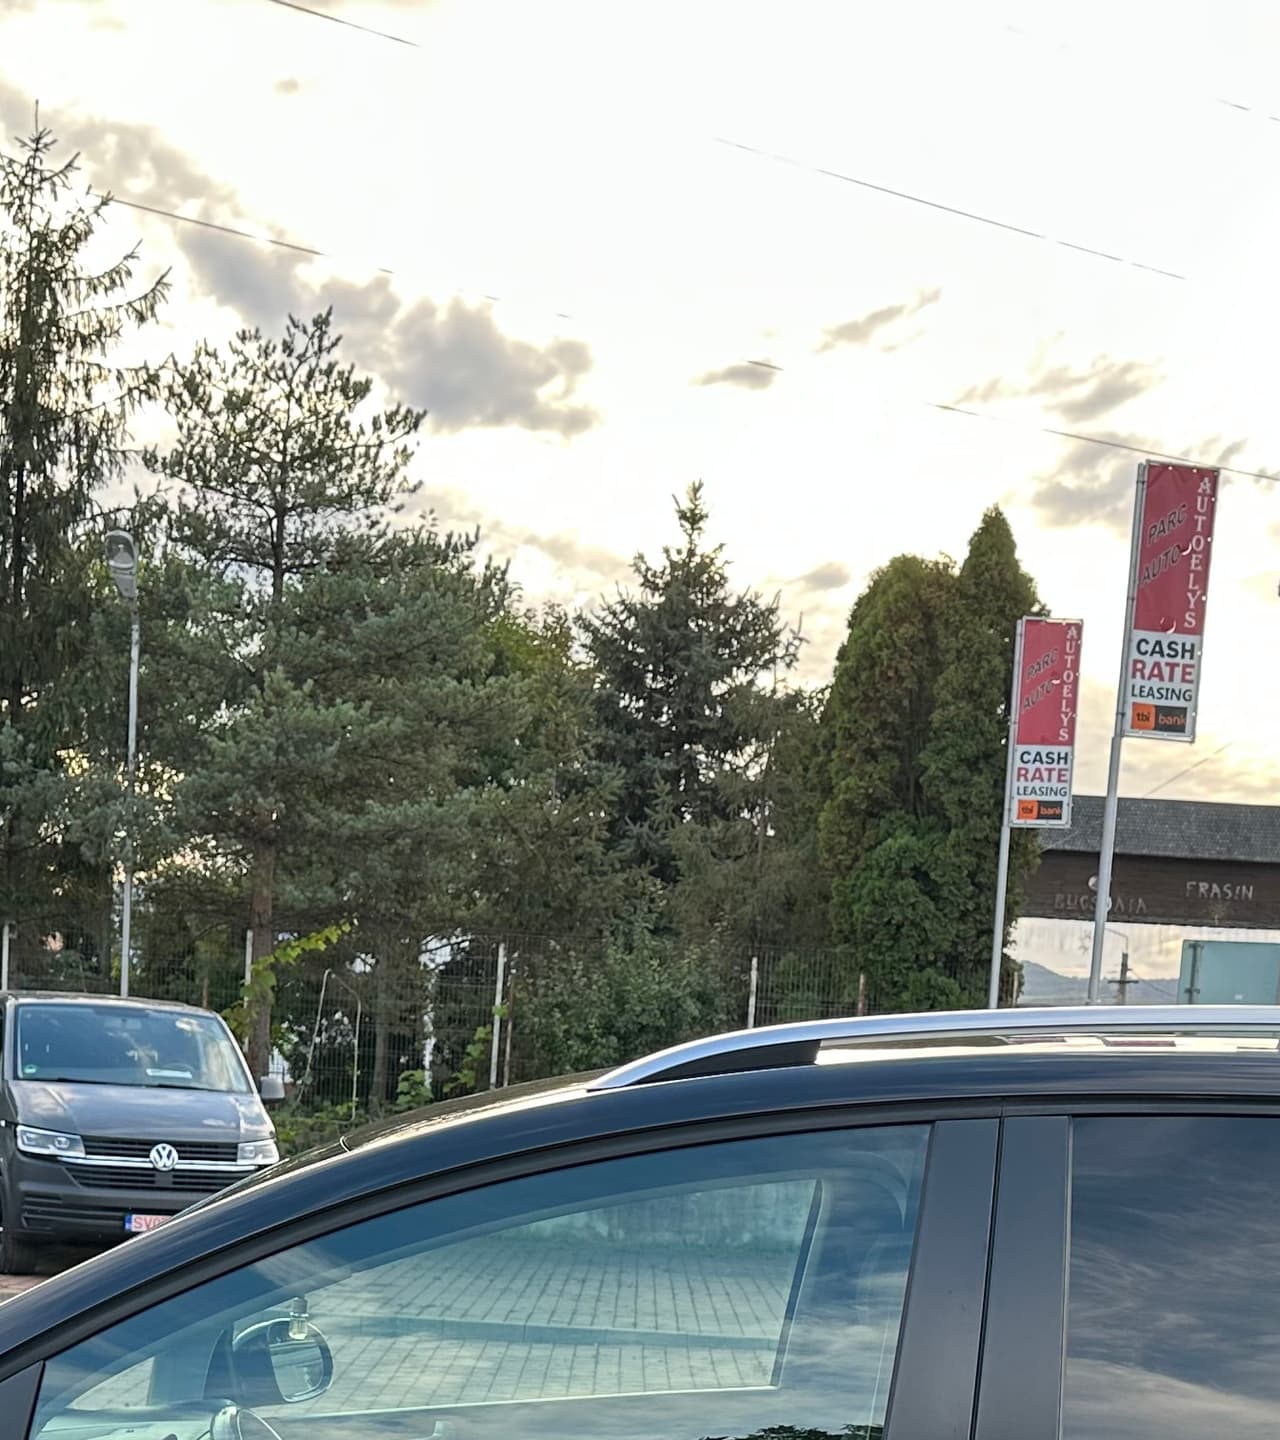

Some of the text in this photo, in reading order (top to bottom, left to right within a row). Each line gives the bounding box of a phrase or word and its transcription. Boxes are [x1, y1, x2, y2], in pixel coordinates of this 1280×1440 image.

[1148, 504, 1188, 545] PARC
[1184, 477, 1213, 629] AUTOELYS
[1136, 638, 1195, 660] CASH
[1131, 659, 1195, 684] RATE
[1059, 626, 1079, 742] AUTOELYS
[1131, 684, 1193, 702] LEASING
[1136, 711, 1186, 726] tbi bank
[1020, 751, 1068, 765] CASH
[1016, 767, 1069, 783] RATE
[1016, 786, 1067, 797] LEASING
[1185, 881, 1254, 900] FRASIN
